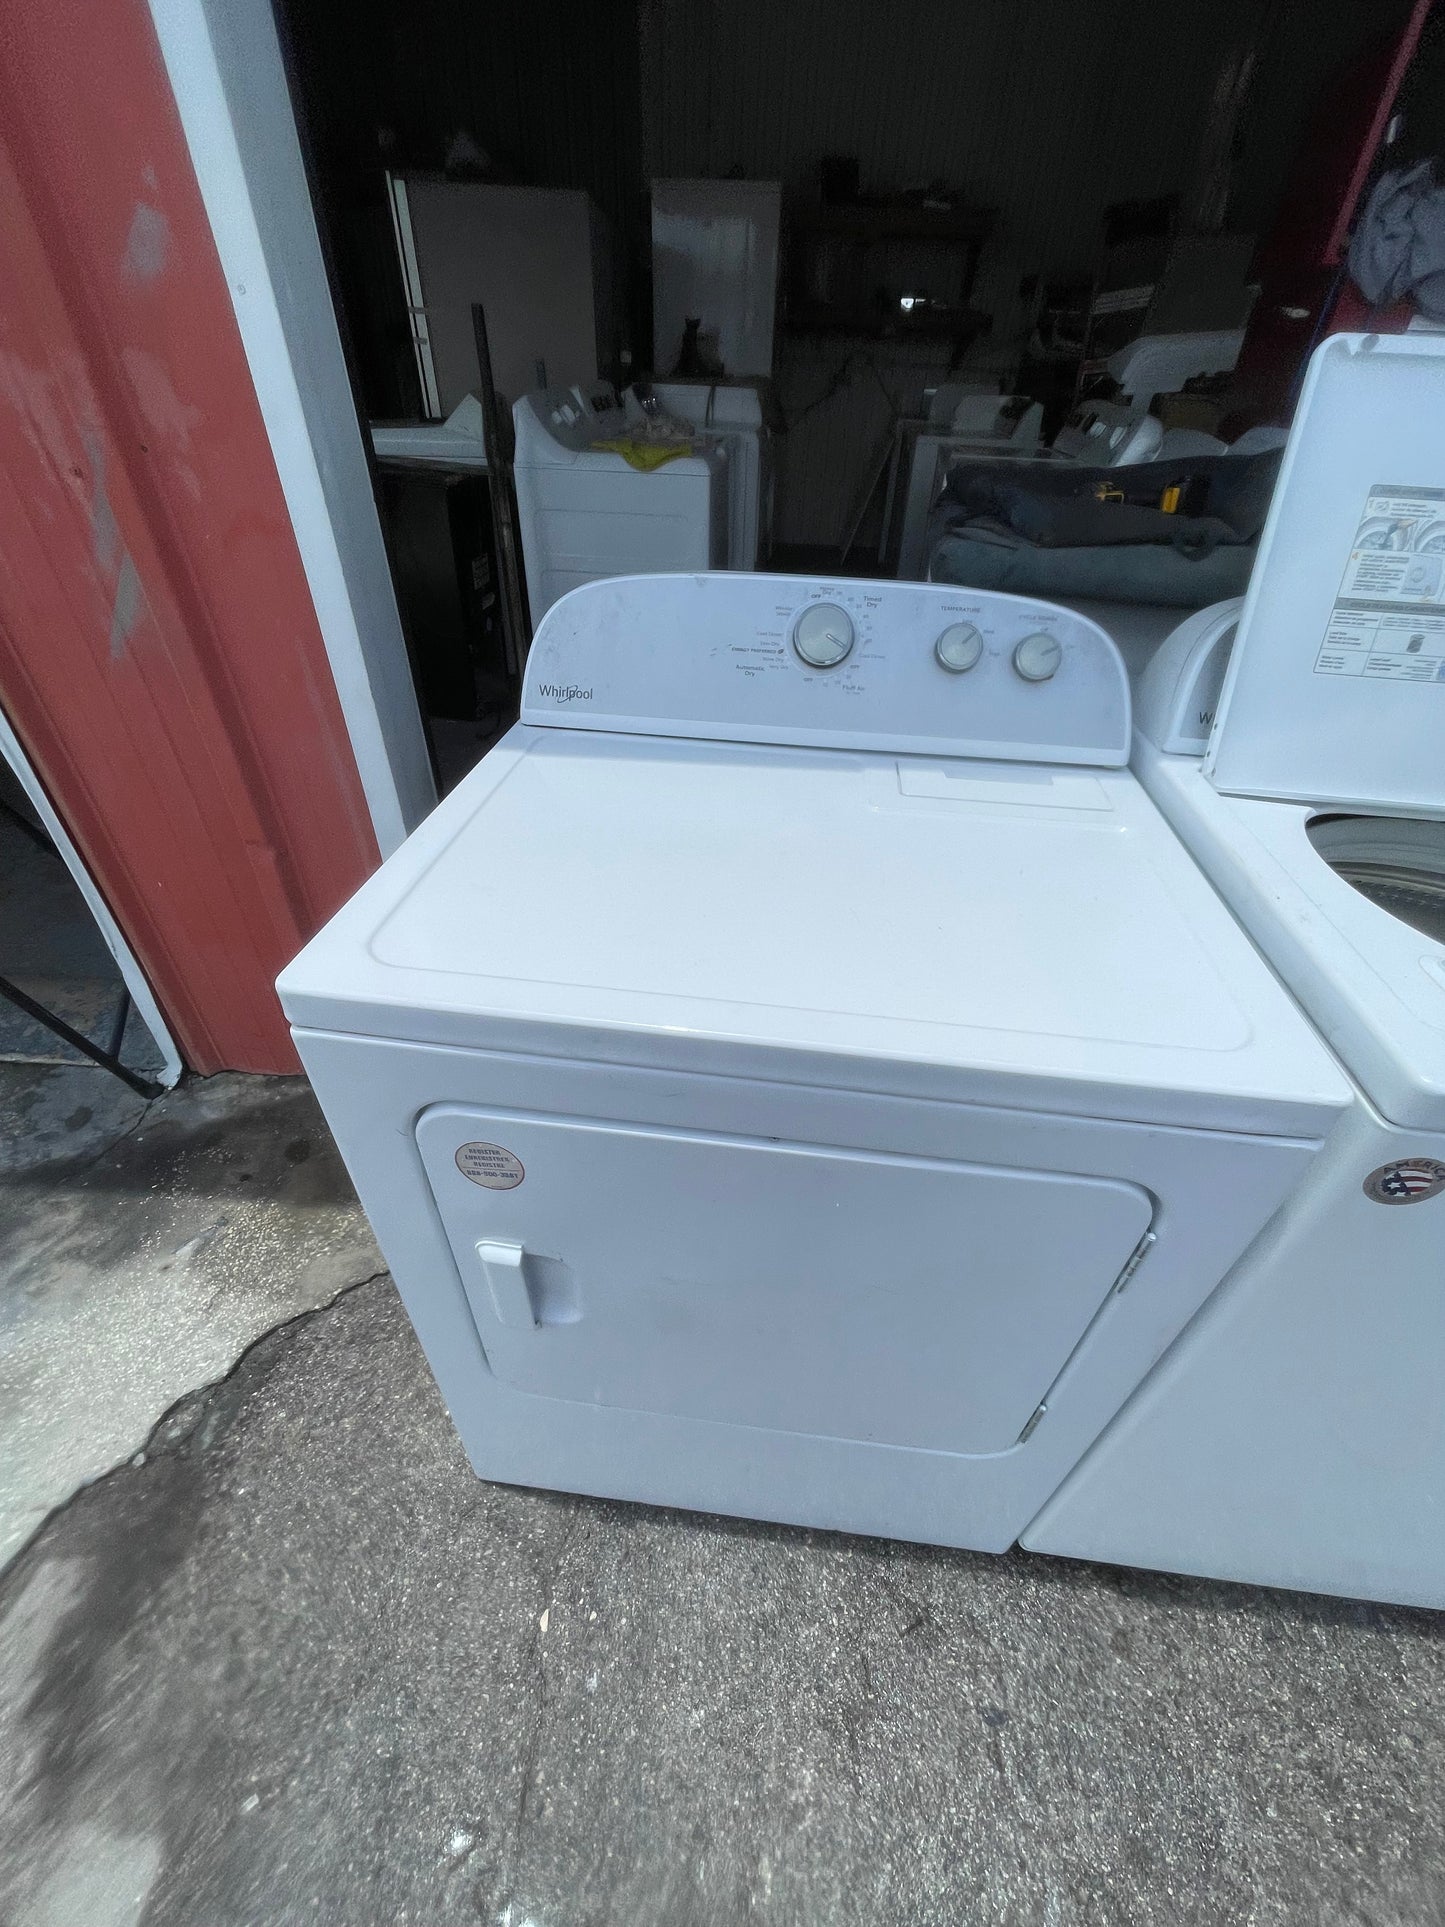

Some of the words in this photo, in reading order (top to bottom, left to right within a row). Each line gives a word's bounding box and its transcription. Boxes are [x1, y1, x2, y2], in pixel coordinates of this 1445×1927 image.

[863, 595, 883, 603] Timed
[866, 601, 878, 609] Dry
[940, 605, 981, 614] TEMPERATURE
[735, 664, 766, 672] Automatic
[744, 670, 756, 678] Dry
[539, 684, 594, 704] Whirlpool
[468, 1148, 501, 1156] REGISTER
